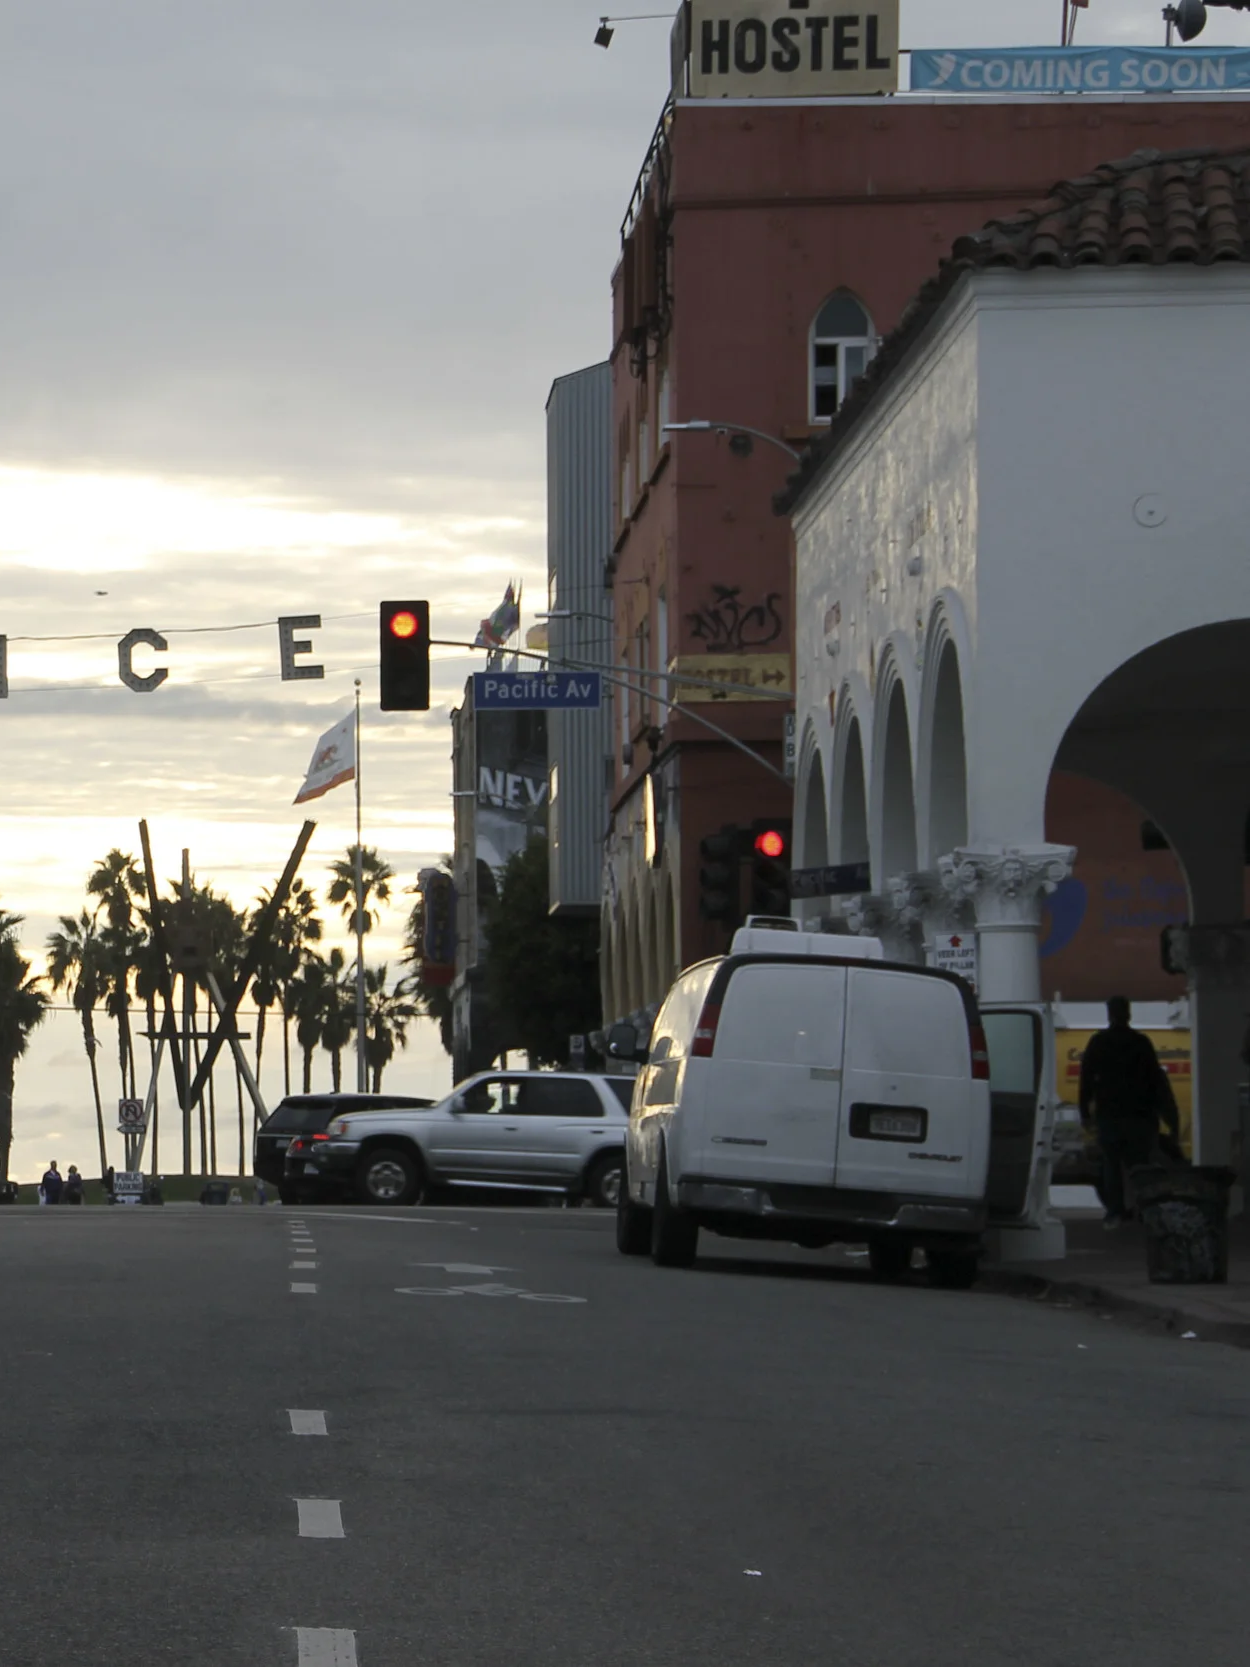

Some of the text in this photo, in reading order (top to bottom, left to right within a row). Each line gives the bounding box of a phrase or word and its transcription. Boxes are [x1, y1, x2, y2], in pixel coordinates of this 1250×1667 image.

[701, 15, 890, 75] HOSTEL
[959, 57, 1227, 89] COMING SOON
[484, 679, 592, 699] Pacific Av
